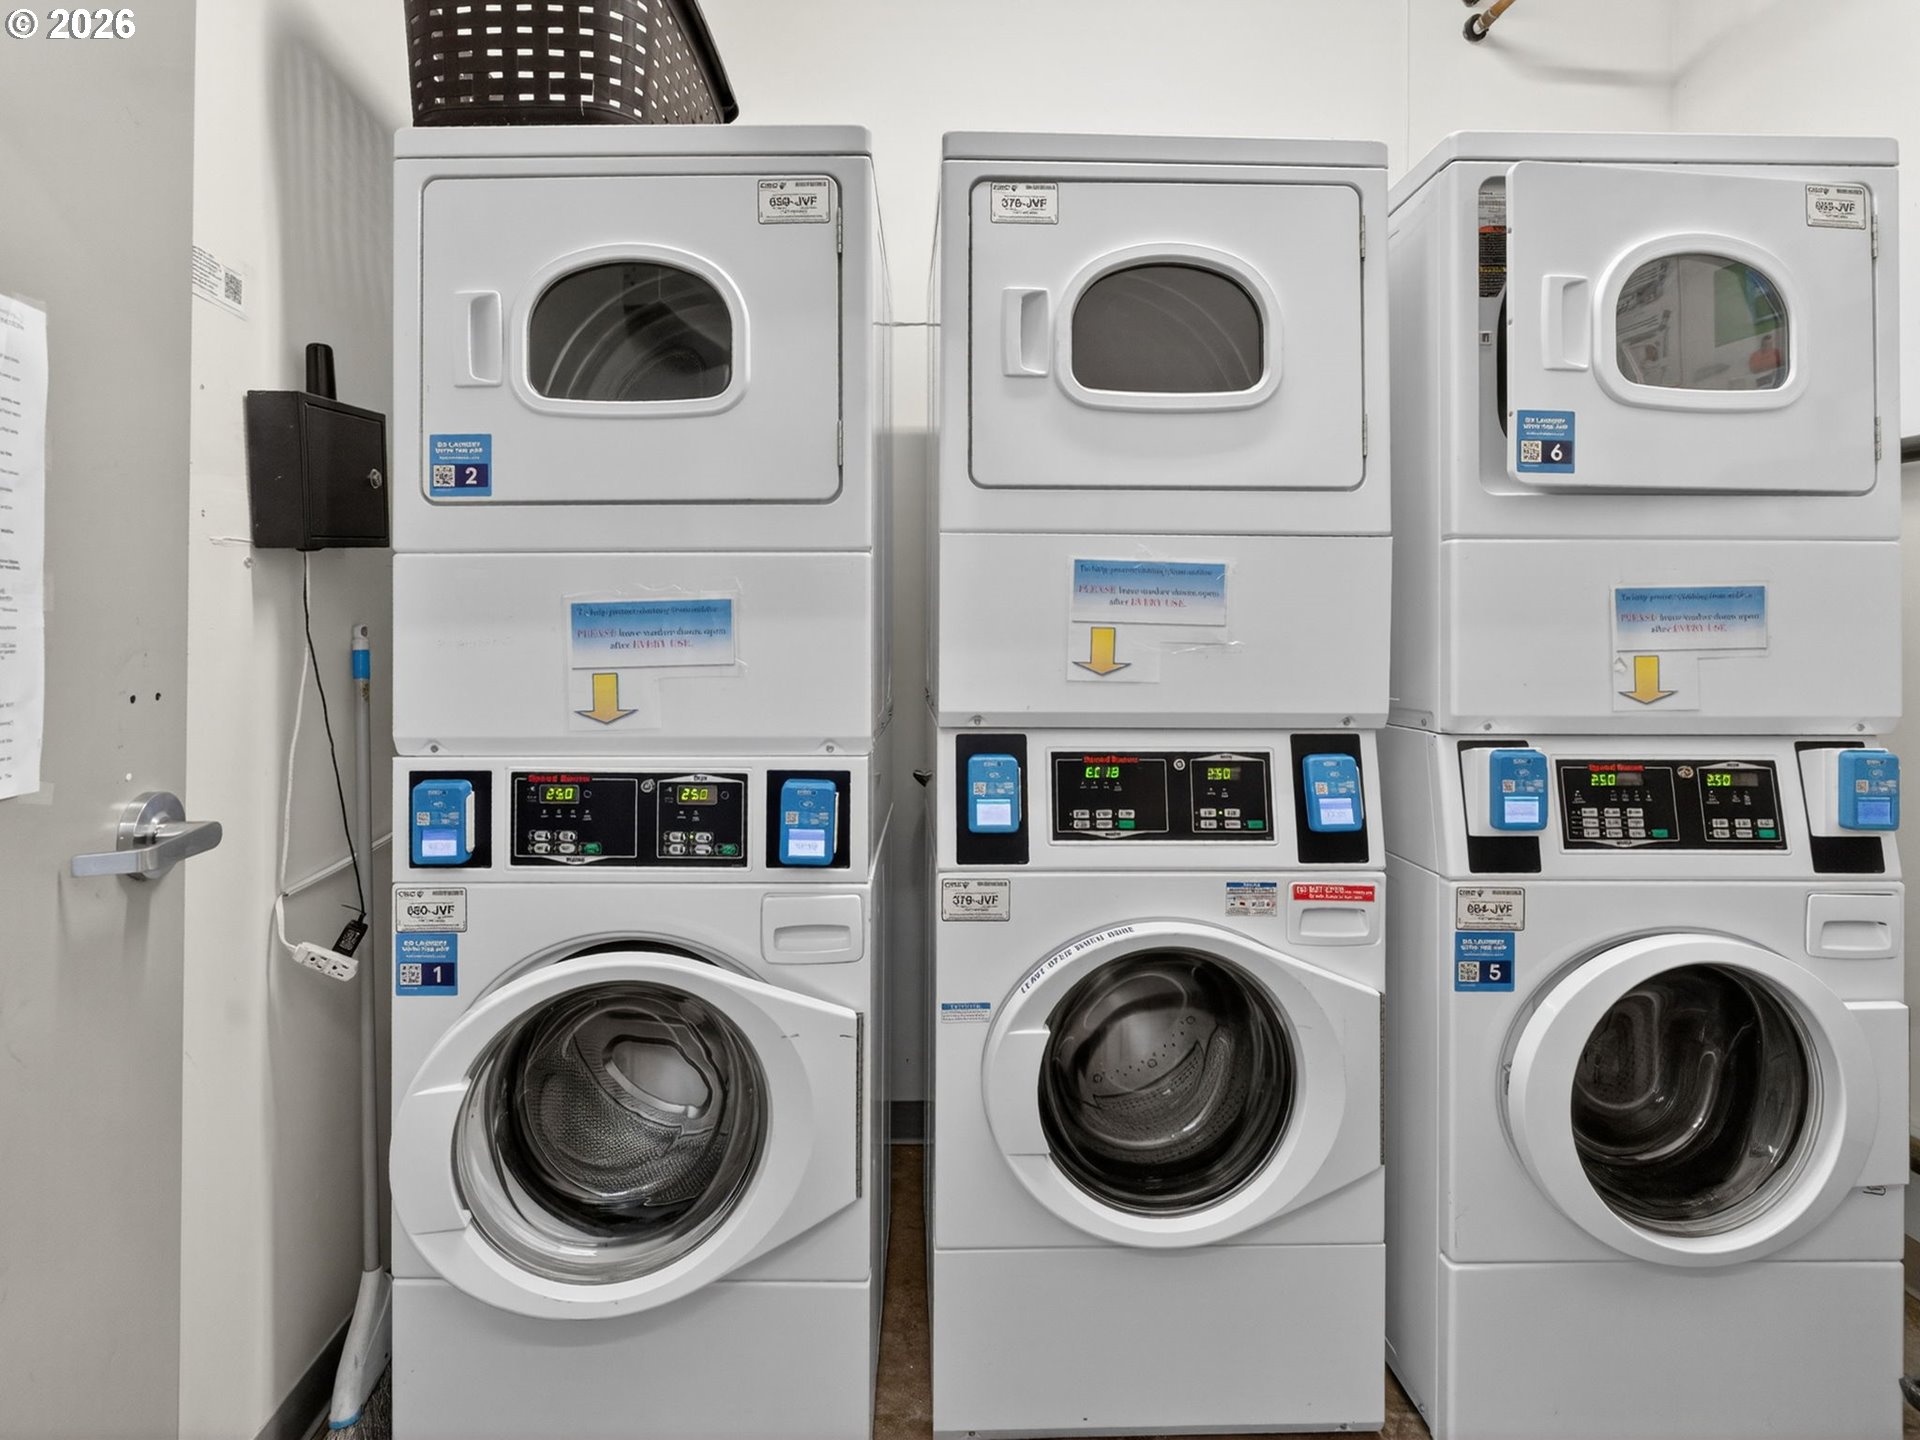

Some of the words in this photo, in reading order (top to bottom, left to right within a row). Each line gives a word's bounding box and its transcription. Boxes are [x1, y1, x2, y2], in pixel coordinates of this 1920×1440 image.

[1550, 443, 1563, 462] 6
[465, 467, 479, 485] 2
[433, 965, 443, 983] 1
[1489, 963, 1501, 981] 5
